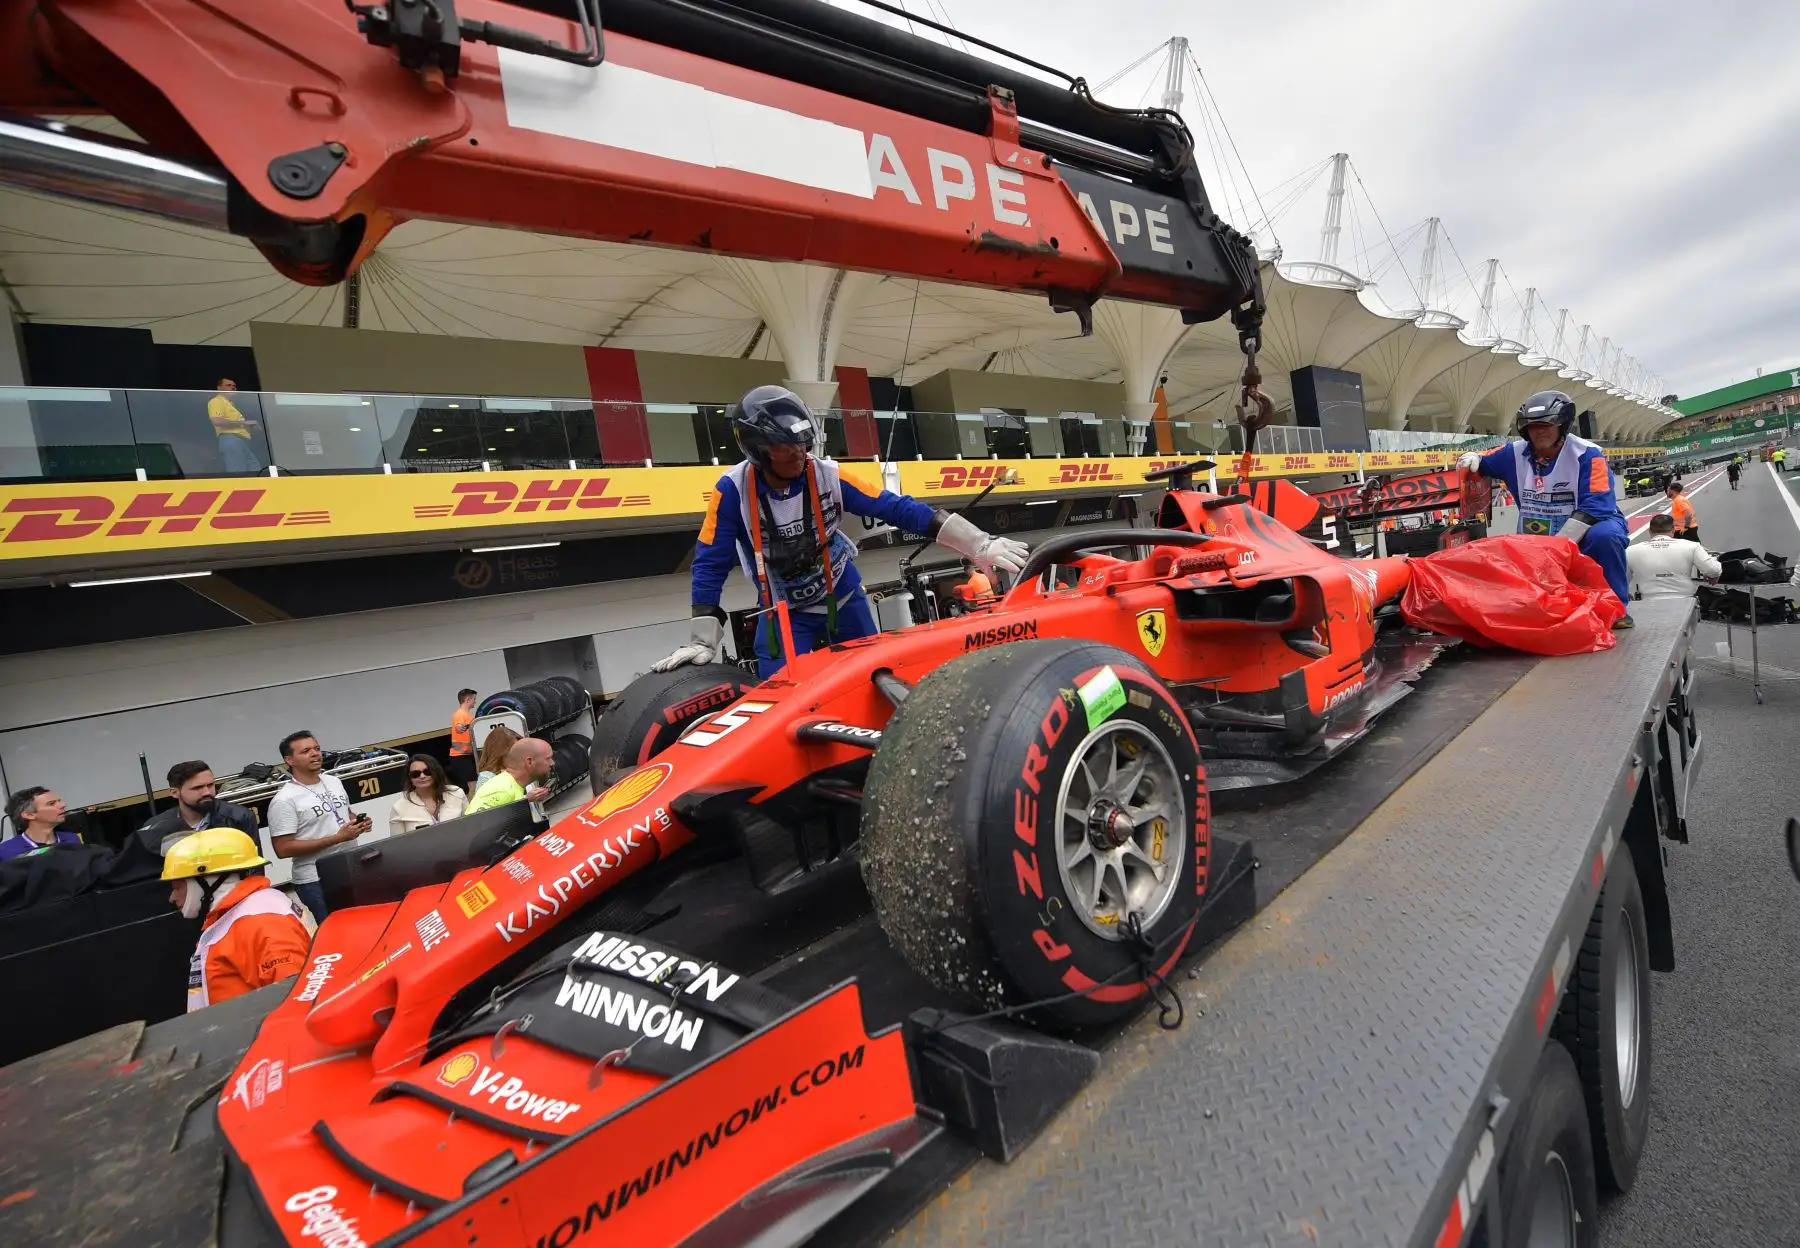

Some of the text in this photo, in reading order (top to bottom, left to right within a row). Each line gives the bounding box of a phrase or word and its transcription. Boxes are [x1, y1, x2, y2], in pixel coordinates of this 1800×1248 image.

[1284, 456, 1312, 469] DHL
[1328, 455, 1349, 468] DHL
[1665, 444, 1690, 456] neken
[1059, 463, 1114, 483] DHL
[1342, 473, 1360, 485] 11
[451, 478, 623, 516] DHL
[1, 489, 286, 543] DHL
[1322, 515, 1341, 549] 5
[497, 554, 558, 571] Haas
[1240, 551, 1256, 565] LOT
[964, 619, 1037, 650] MISSION
[664, 682, 736, 724] PIRELLI
[1324, 681, 1363, 713] Lenovo
[679, 700, 779, 747] 5
[813, 721, 884, 739] Lenov
[359, 777, 380, 798] 20
[1012, 695, 1069, 900] ZERO
[311, 796, 349, 818] BOSS
[495, 816, 650, 943] KASPERSKY
[415, 908, 450, 952] MAHLE
[260, 955, 291, 973] Nomex
[554, 974, 704, 1052] WINNOW
[469, 1066, 580, 1123] V-Power
